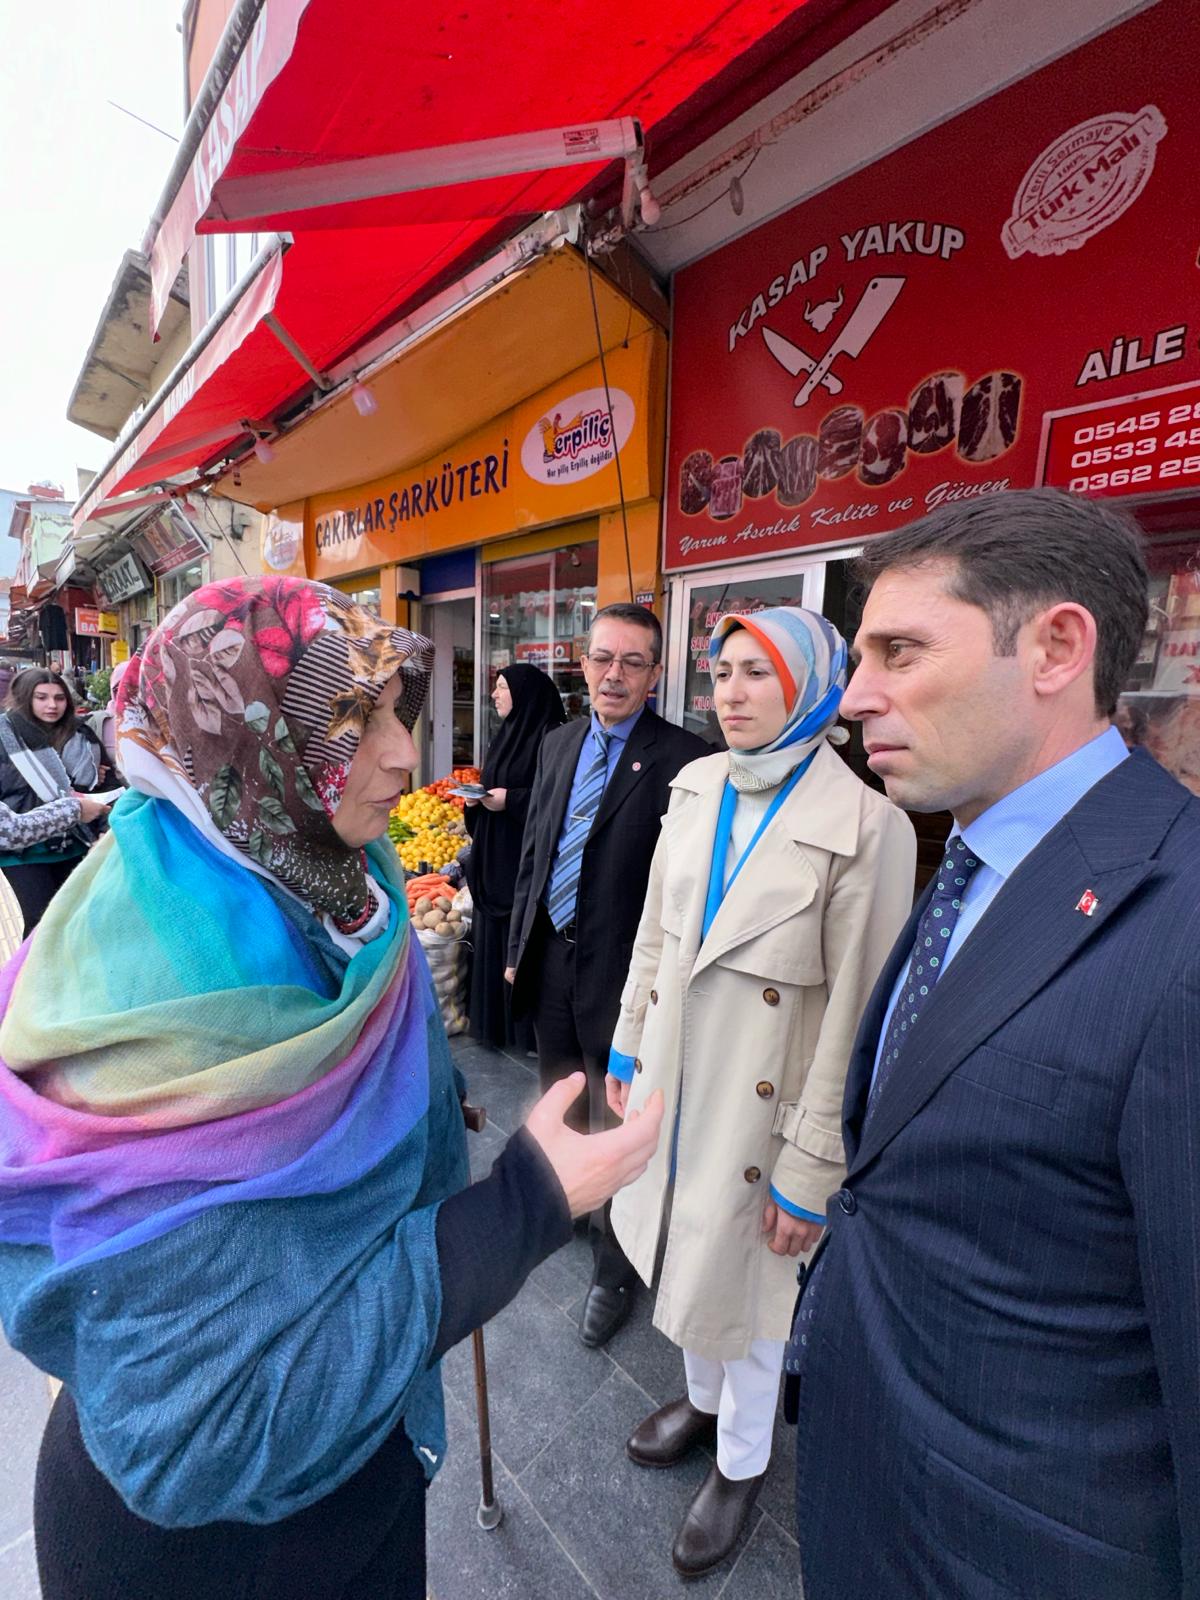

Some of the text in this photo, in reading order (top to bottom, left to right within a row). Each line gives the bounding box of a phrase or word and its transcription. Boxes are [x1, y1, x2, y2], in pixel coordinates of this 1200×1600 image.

[1023, 134, 1141, 229] Türk Malı
[1026, 125, 1113, 203] Yerli Sermaye
[728, 221, 965, 352] KASAP YAKUP
[1076, 325, 1186, 386] AİLE
[554, 414, 611, 455] erpiliç
[1071, 437, 1157, 468] 0533
[1073, 411, 1161, 445] 0545
[315, 499, 386, 556] ÇAKIRLAR
[388, 438, 510, 533] ŞARKÜTERİ
[1069, 465, 1152, 492] 0362
[679, 535, 728, 556] Yarım
[811, 502, 879, 528] Kalite
[888, 495, 913, 513] ve
[924, 478, 1010, 511] Güven
